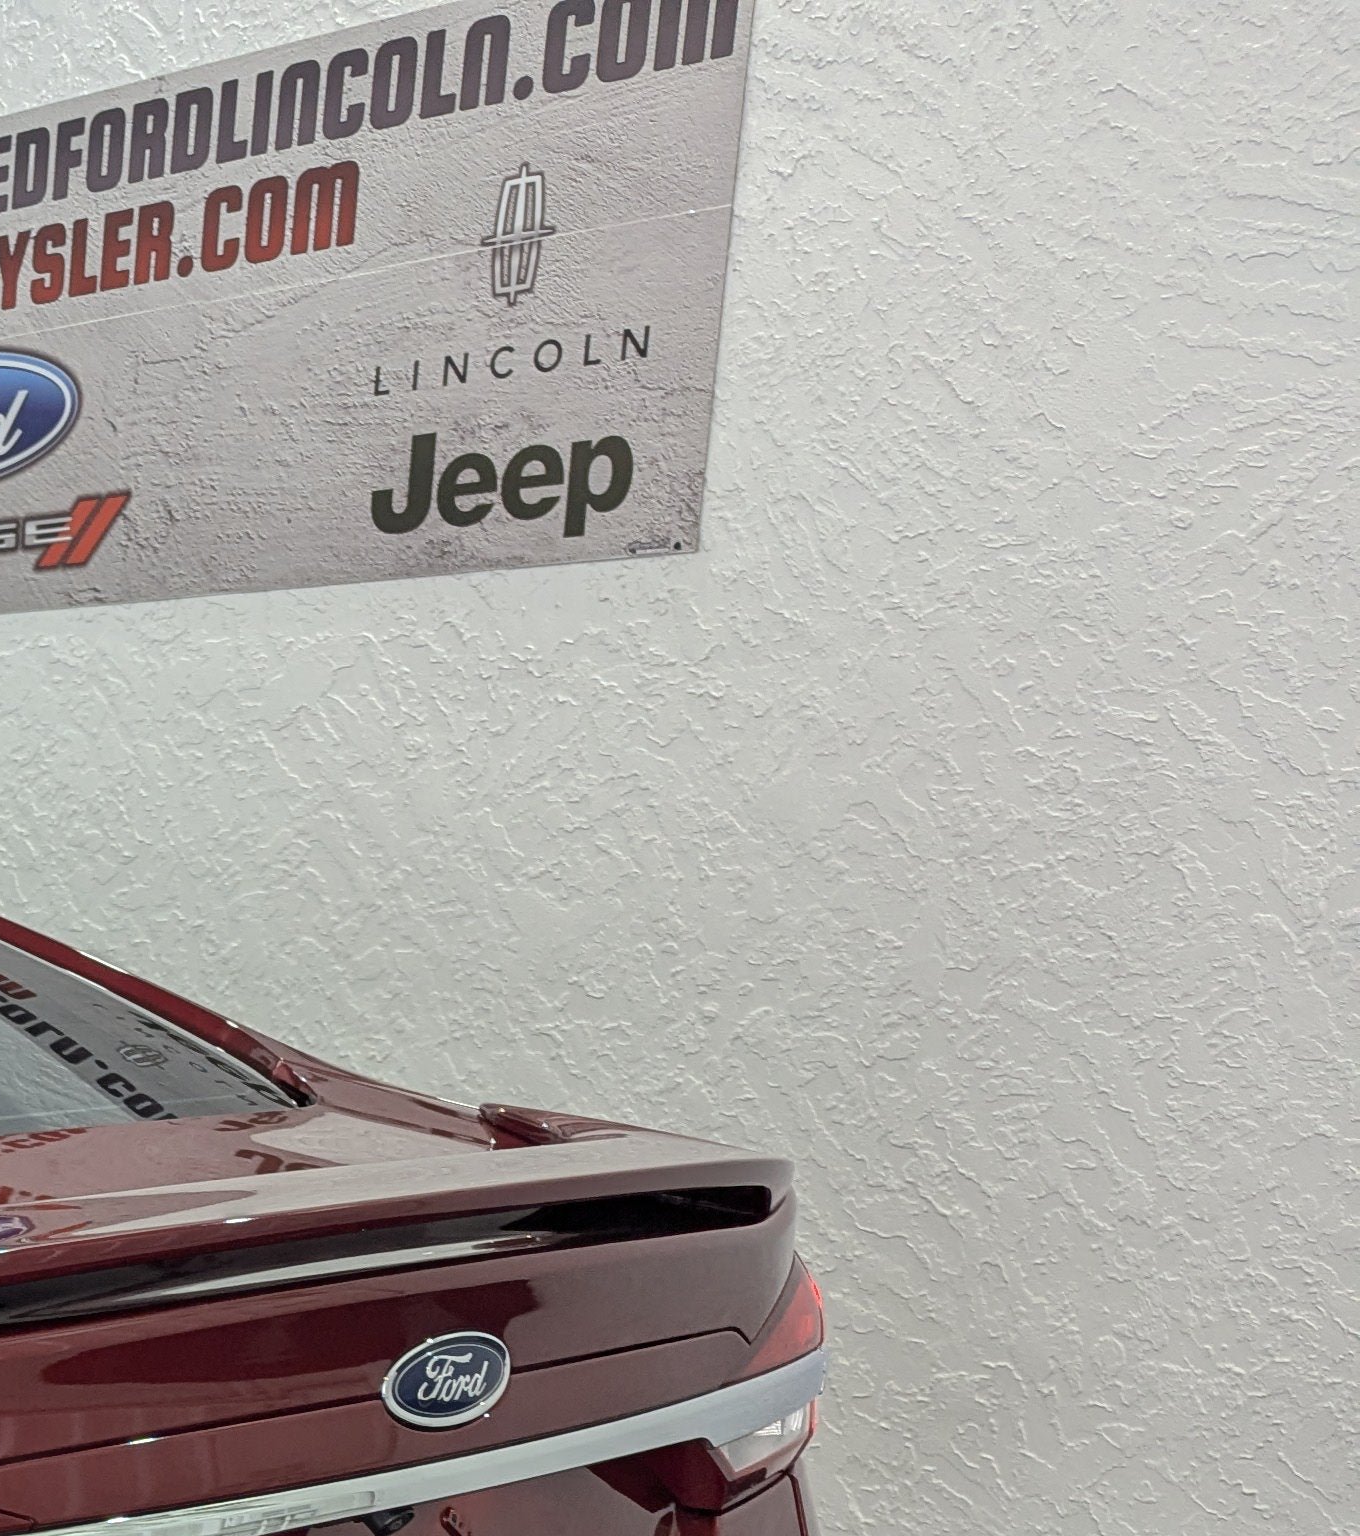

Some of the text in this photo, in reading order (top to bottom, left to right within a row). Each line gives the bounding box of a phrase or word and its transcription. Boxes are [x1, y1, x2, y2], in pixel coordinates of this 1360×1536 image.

[373, 325, 651, 396] LINCOLN
[371, 432, 634, 538] Jeep
[417, 1352, 487, 1405] Ford
